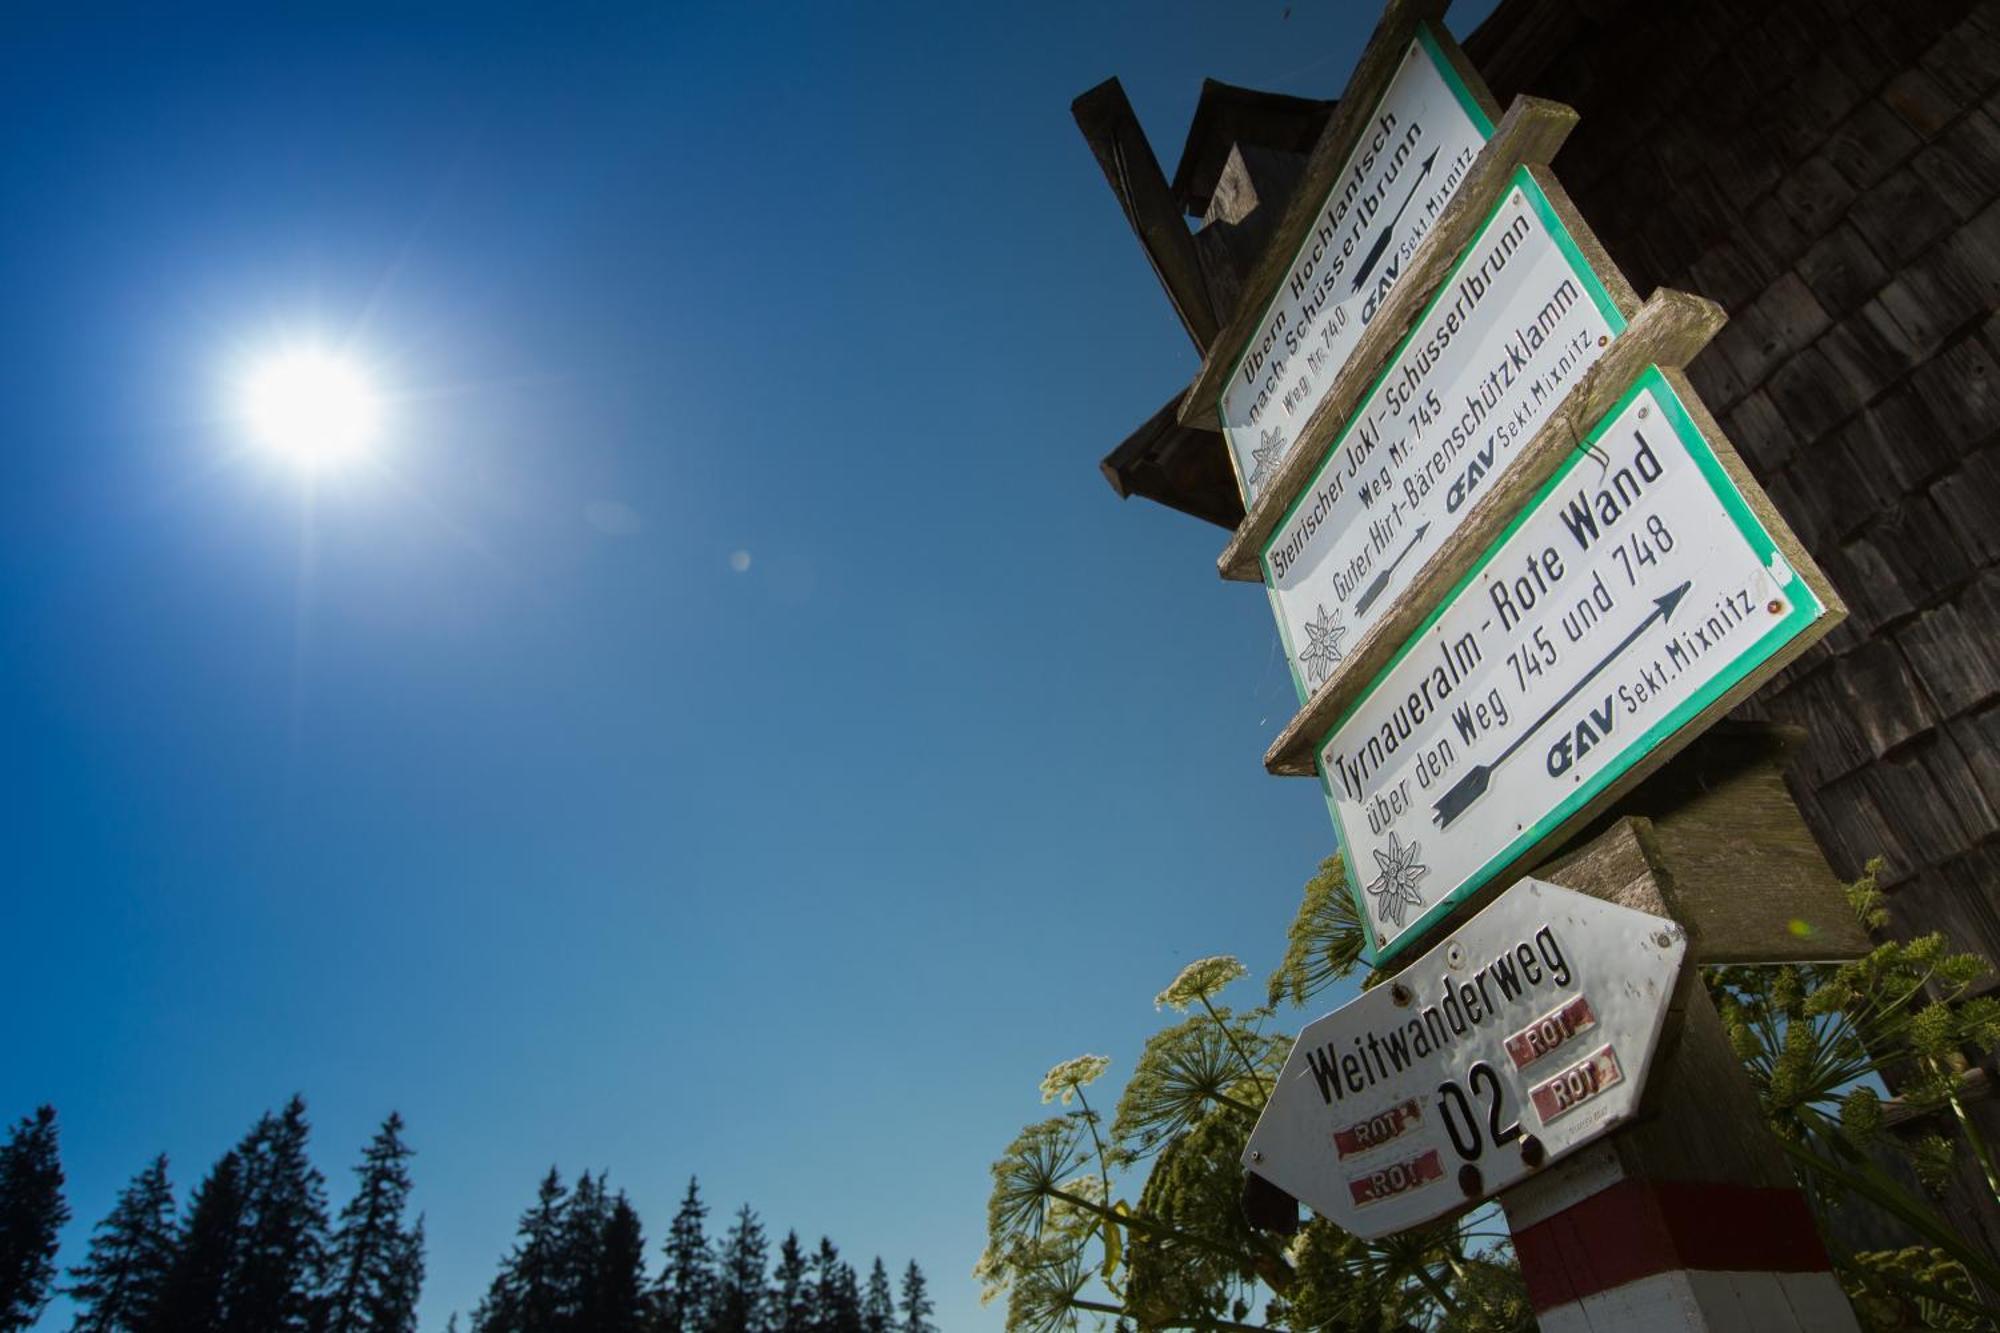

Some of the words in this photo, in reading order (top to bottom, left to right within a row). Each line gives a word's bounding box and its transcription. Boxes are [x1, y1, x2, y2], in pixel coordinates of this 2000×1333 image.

[1243, 310, 1286, 385] Übern
[1290, 111, 1398, 300] Hochlantsch
[1249, 360, 1285, 423] nach
[1285, 121, 1422, 356] Schüsserlbrunn
[1281, 376, 1309, 415] Weg
[1358, 467, 1392, 510] Weg
[1409, 389, 1441, 440] 745
[1273, 471, 1344, 579] Steirischer
[1559, 430, 1664, 551] Wand
[1333, 544, 1374, 602] Guter
[1367, 778, 1409, 835] über
[1415, 737, 1455, 789] den
[1452, 688, 1509, 747] Weg
[1506, 625, 1558, 692] 745
[1562, 570, 1614, 642] und
[1612, 514, 1675, 587] 748
[1306, 924, 1573, 1104] Weitwanderweg
[1527, 1011, 1575, 1058] ROT
[1437, 1060, 1521, 1162] 02
[1550, 1062, 1599, 1111] ROT
